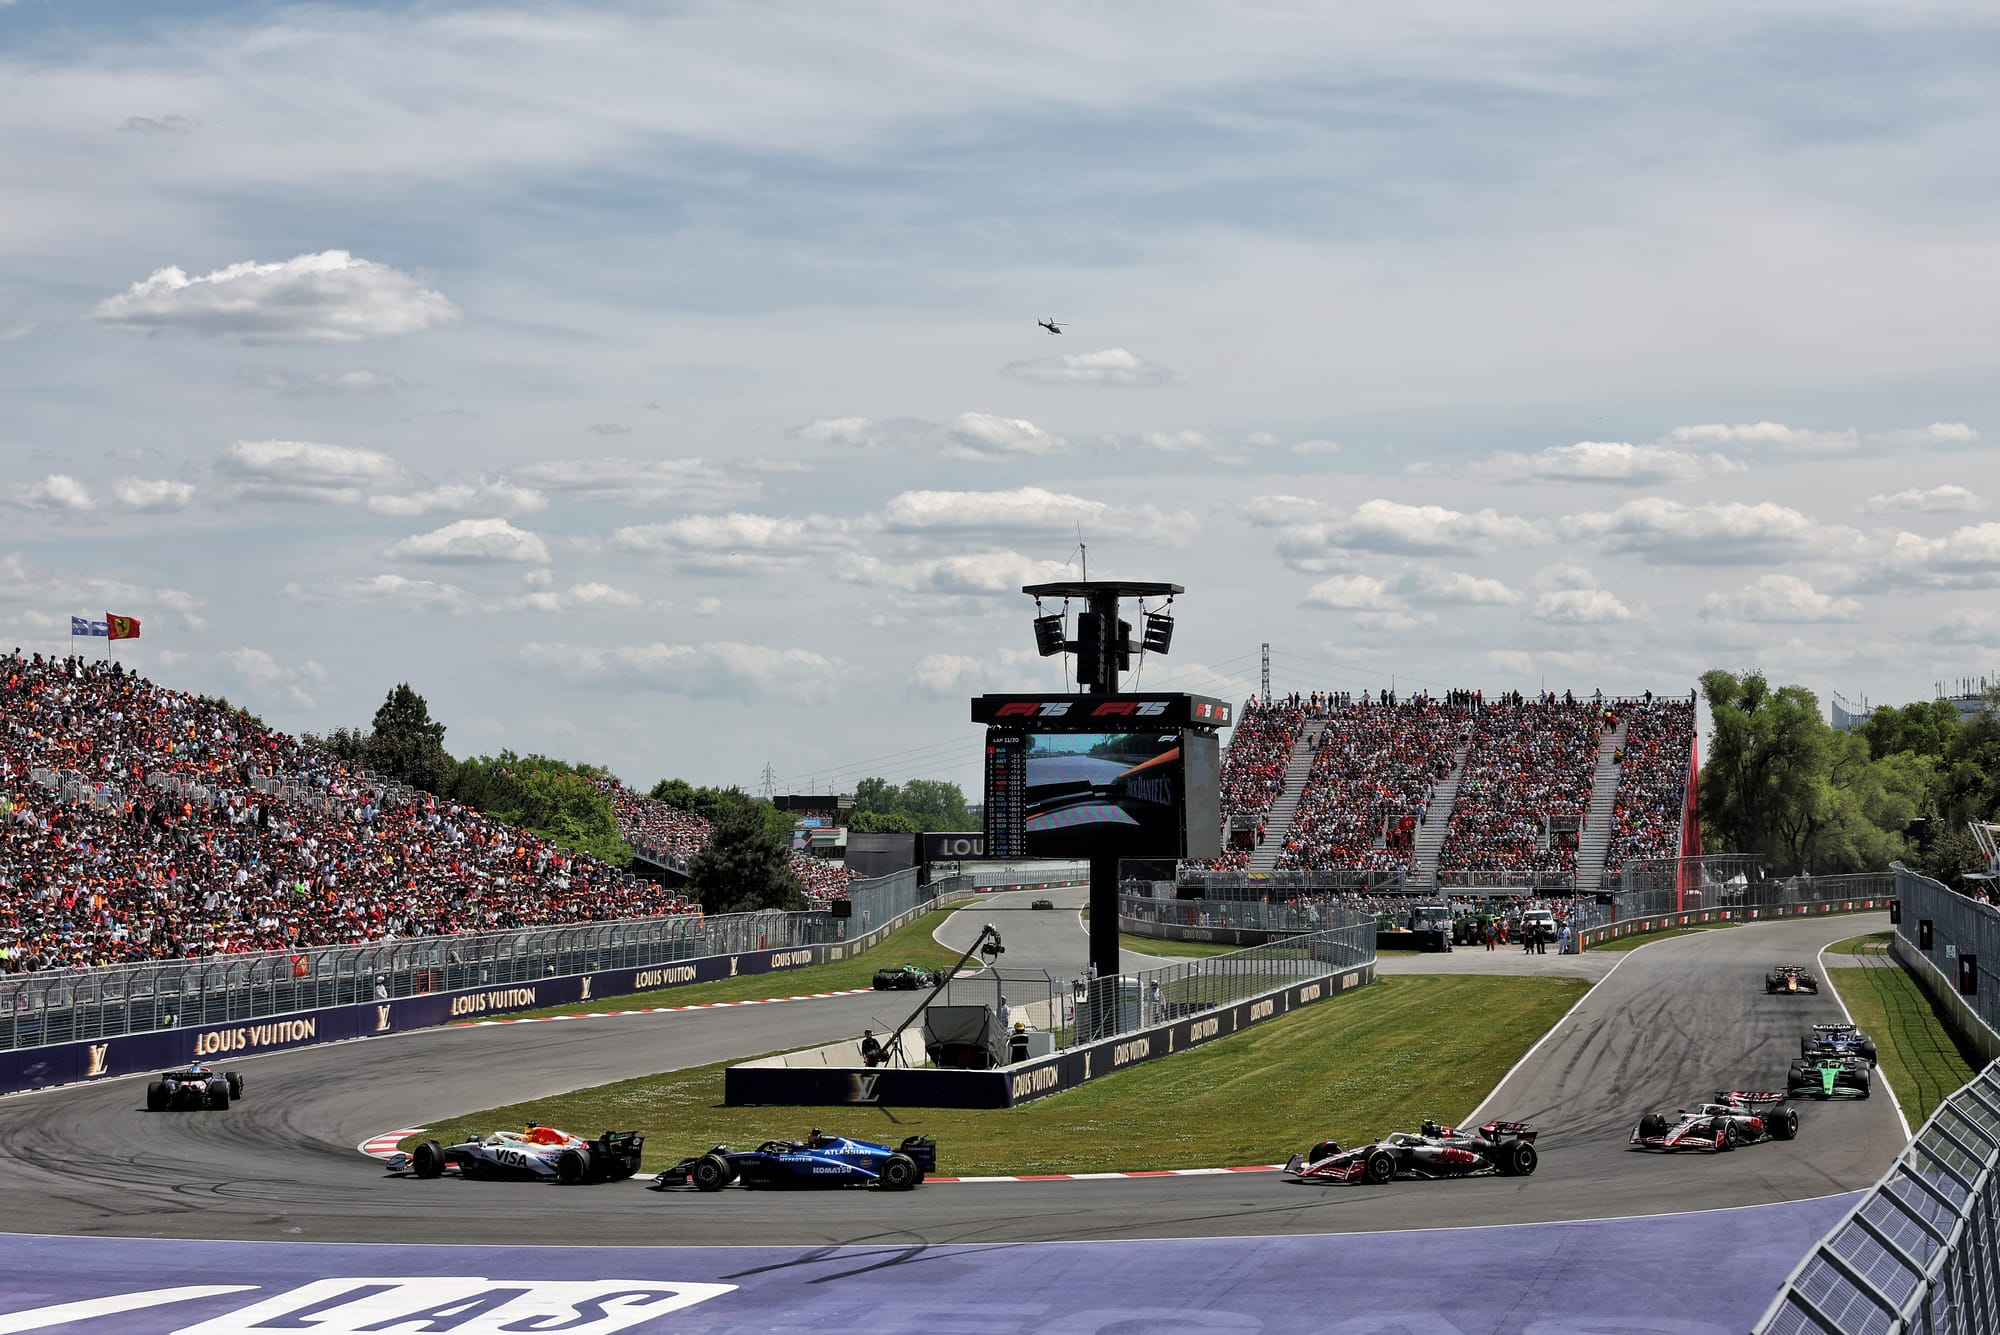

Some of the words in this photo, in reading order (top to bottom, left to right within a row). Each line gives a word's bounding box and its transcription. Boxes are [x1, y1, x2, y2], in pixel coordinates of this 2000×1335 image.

[771, 952, 790, 968] LOUIS
[792, 949, 812, 965] VUITTON
[635, 969, 662, 989] LOUIS
[663, 965, 697, 984] VUITTON
[451, 993, 486, 1016] LOUIS
[488, 987, 535, 1009] VUITTON
[195, 1028, 246, 1055] LOUIS
[249, 1017, 316, 1047] VUITTON
[1114, 1042, 1129, 1066] LOUIS
[1130, 1036, 1150, 1061] VUITTON
[1012, 1071, 1031, 1099] LOUIS
[1032, 1063, 1059, 1092] VUITTON
[496, 1148, 528, 1168] VISA
[812, 1166, 852, 1174] KOMATSU
